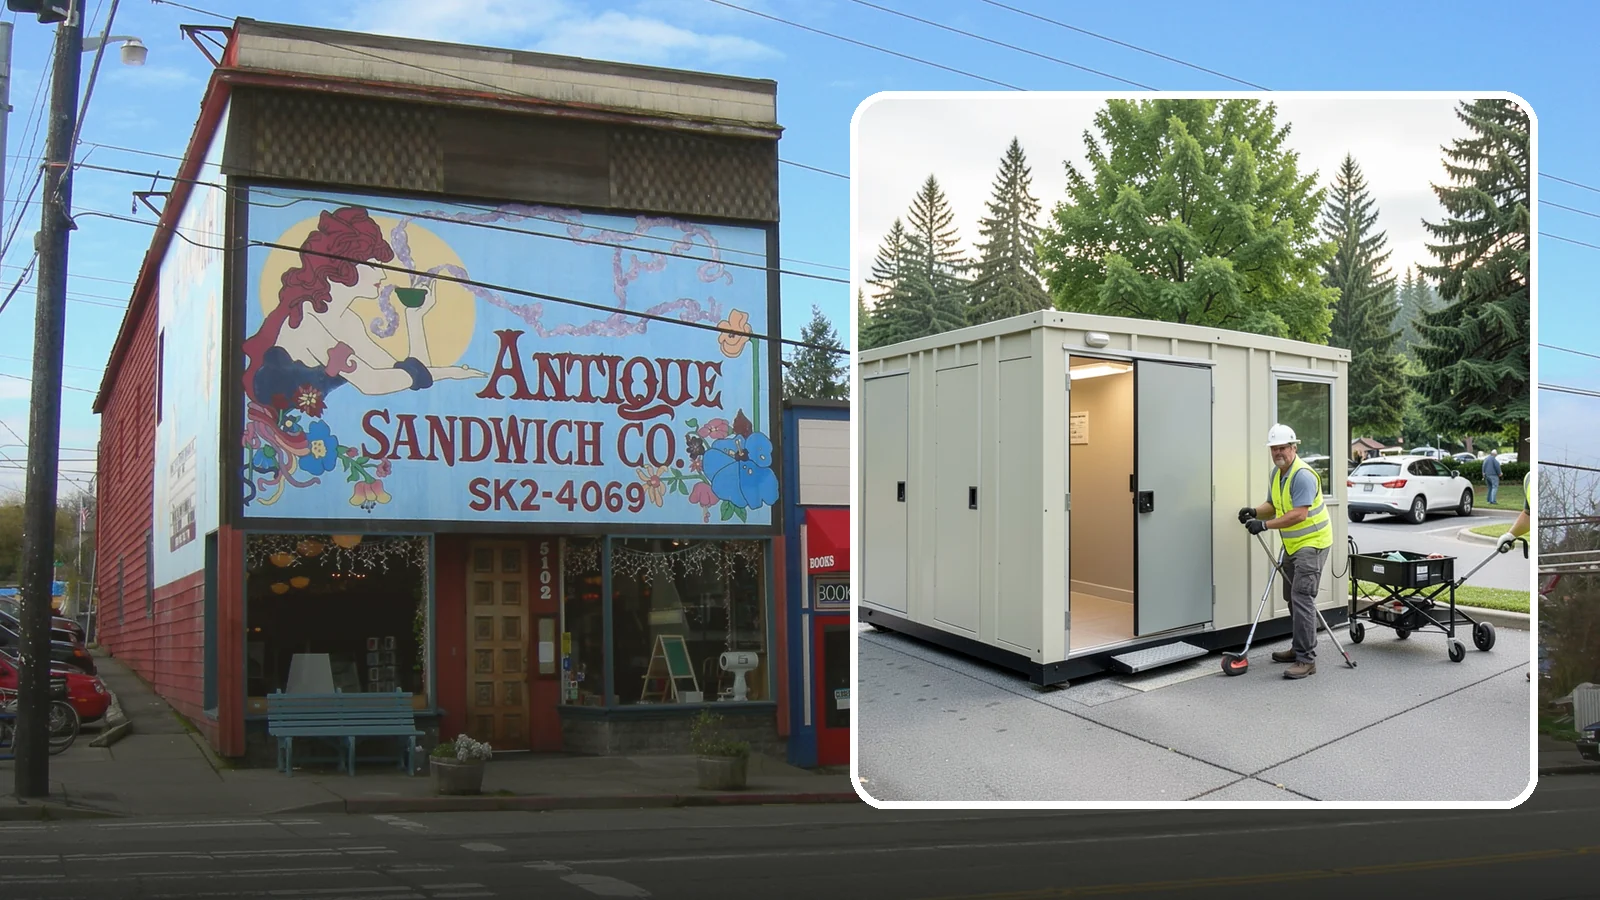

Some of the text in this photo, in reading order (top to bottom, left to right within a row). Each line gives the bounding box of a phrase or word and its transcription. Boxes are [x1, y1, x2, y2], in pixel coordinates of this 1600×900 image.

[476, 329, 724, 422] ANTIQUE
[361, 408, 685, 468] SANDWICH CO.
[468, 477, 646, 512] SK2-4069
[539, 542, 551, 600] 5102
[809, 555, 835, 569] BOOKS
